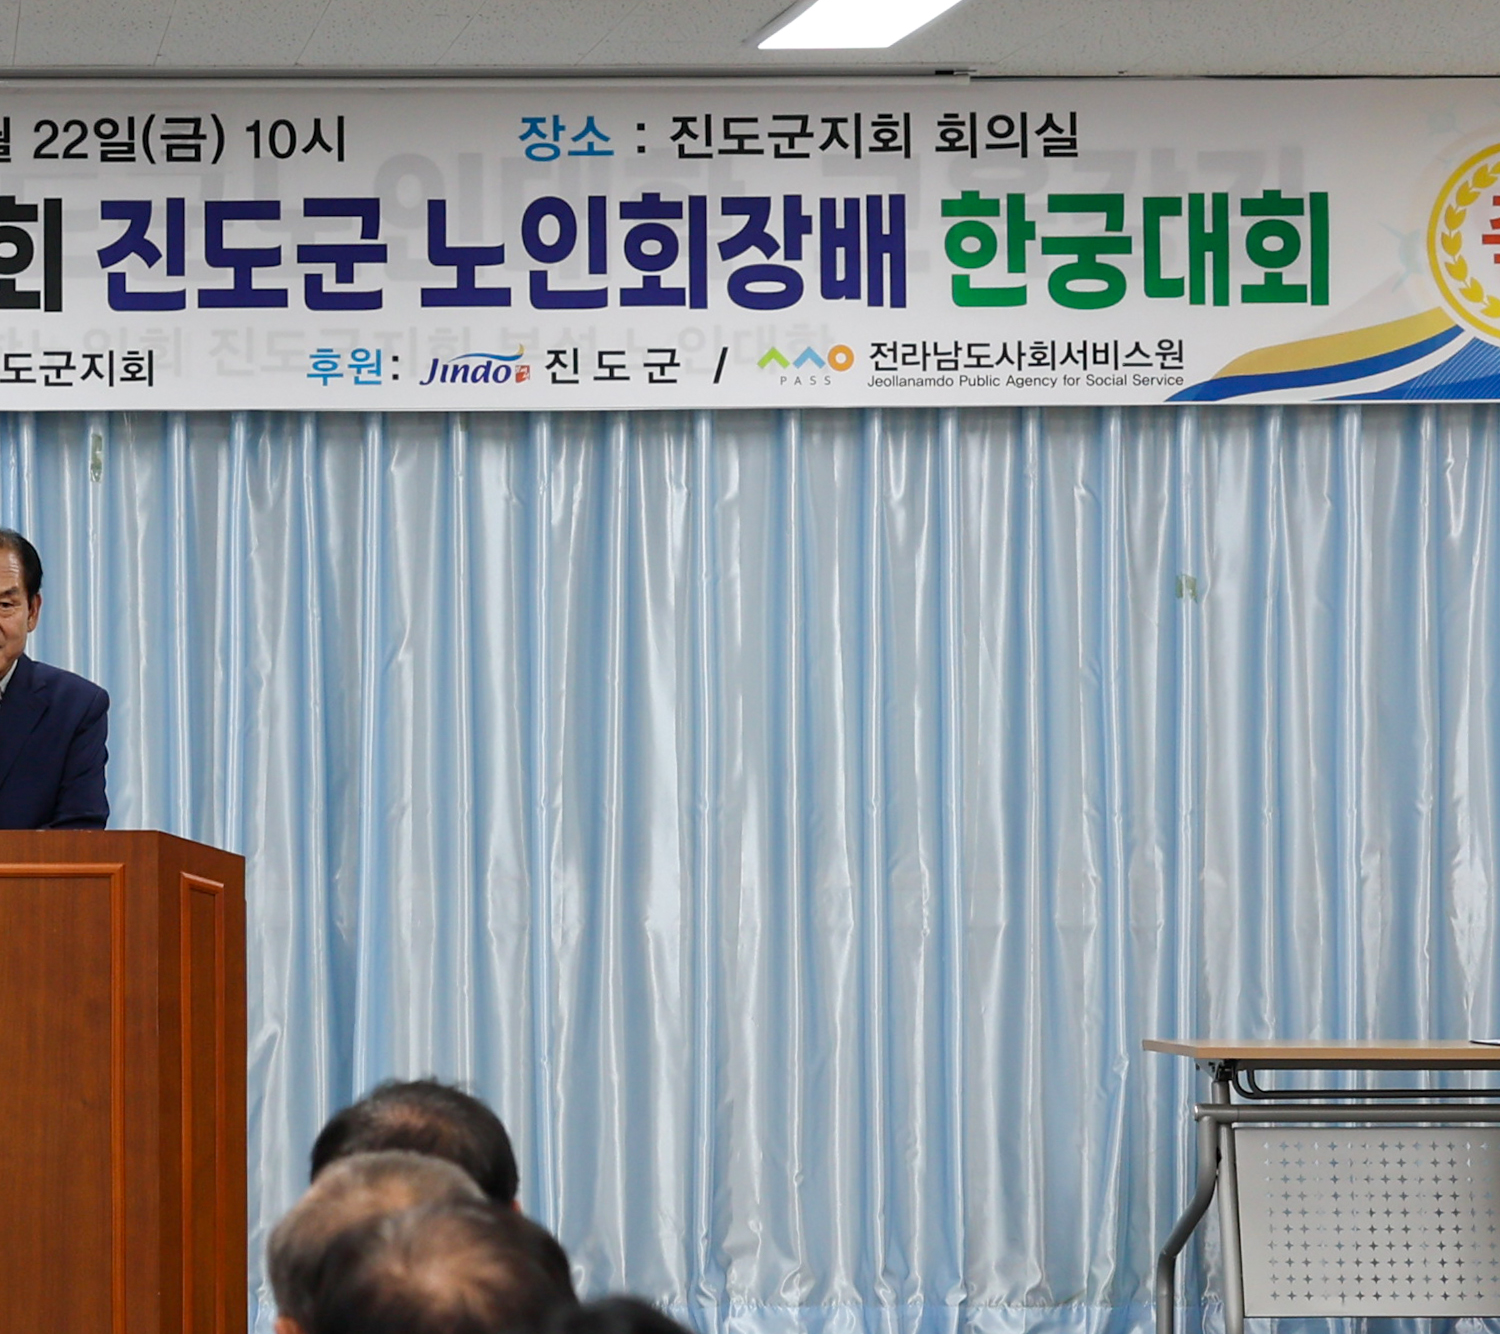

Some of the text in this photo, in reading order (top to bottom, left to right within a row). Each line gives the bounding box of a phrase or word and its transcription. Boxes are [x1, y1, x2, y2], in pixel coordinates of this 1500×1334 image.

[33, 113, 225, 165] 22일(금)
[245, 115, 345, 162] 10시
[518, 111, 1079, 162] 장소 : 진도군지회 회의실
[96, 197, 388, 312] 진도군
[420, 192, 907, 311] 노인회장배
[941, 189, 1329, 310] 한궁대회
[306, 348, 399, 386] 후원:
[419, 351, 518, 386] Jindo
[545, 347, 681, 385] 진도군
[780, 375, 831, 386] PASS
[869, 338, 1184, 372] 전라남도사회서비스원
[867, 373, 1184, 389] Jeollanamdo Public Agency for Social Service
